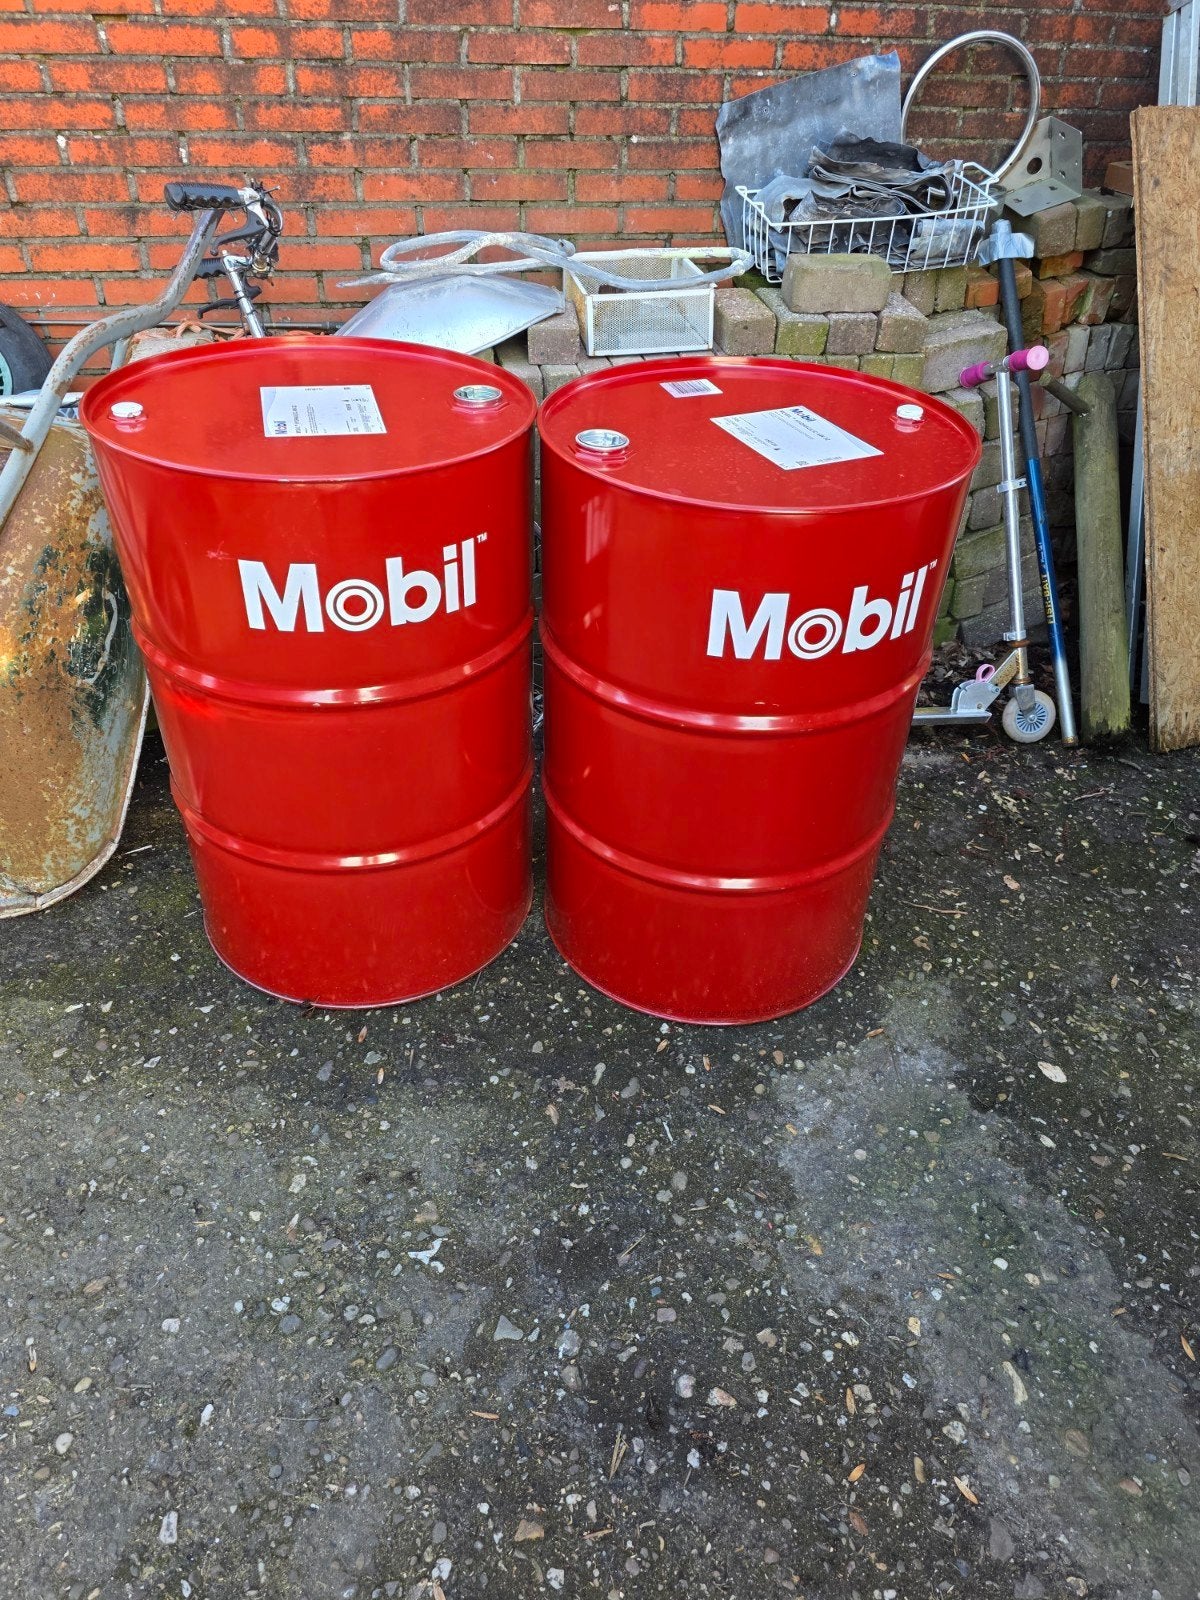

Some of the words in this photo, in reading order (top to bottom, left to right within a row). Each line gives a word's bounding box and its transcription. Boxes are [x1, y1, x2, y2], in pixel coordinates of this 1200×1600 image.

[791, 408, 818, 422] Mobil
[237, 537, 476, 633] Mobil
[706, 564, 928, 661] Mobil
